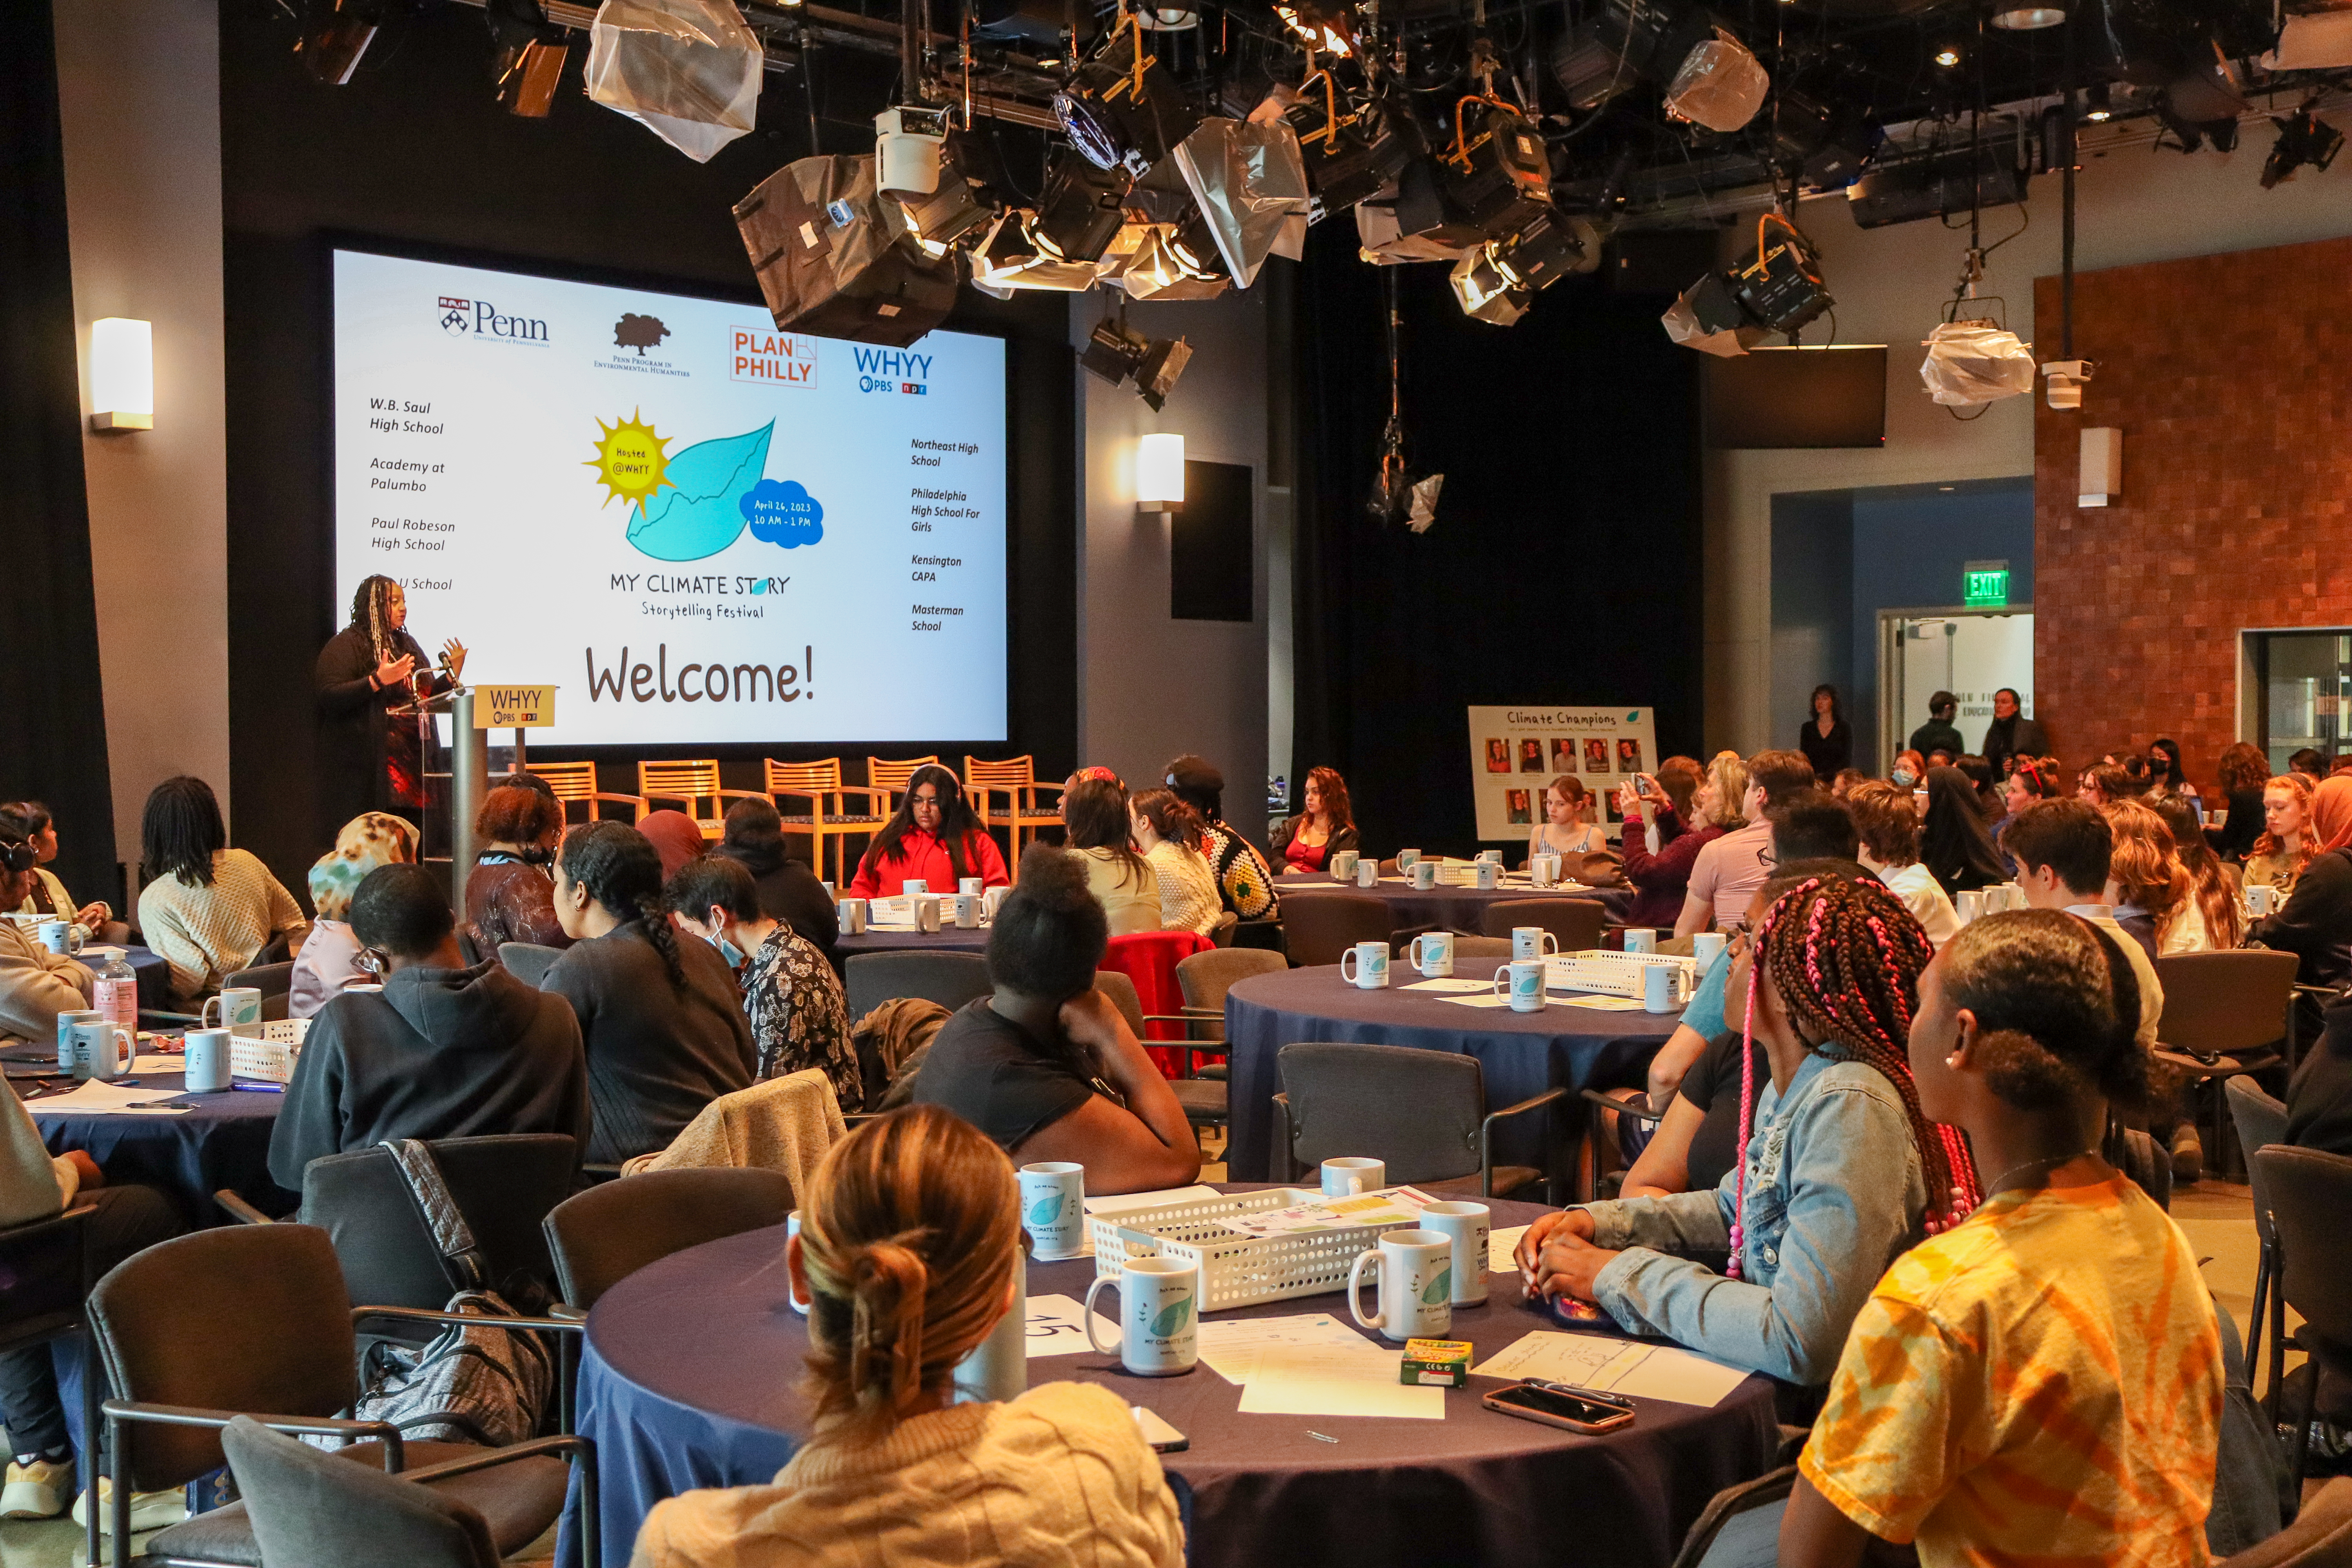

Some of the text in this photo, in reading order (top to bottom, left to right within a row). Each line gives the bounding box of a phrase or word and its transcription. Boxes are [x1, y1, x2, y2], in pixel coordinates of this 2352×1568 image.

[473, 301, 550, 341] Penn
[735, 332, 792, 357] PLAN
[735, 356, 811, 382] PHILLY
[853, 347, 933, 379] WHYY
[874, 380, 926, 395] PBS npr
[370, 397, 431, 414] W.B. Saul
[370, 417, 444, 434] High School
[617, 448, 645, 458] Hosted
[911, 439, 979, 455] Northeast High
[370, 457, 445, 475] Academy at
[911, 455, 941, 466] School
[613, 463, 650, 475] @WHYY
[371, 478, 426, 492] Palumbo
[911, 488, 967, 502] Philadelphia
[754, 500, 811, 513] April 26, 2023
[911, 505, 980, 519] High School For
[371, 517, 455, 532] Paul Robeson
[754, 515, 765, 524] 10
[768, 516, 782, 525] AM
[790, 518, 795, 526] 1
[799, 518, 811, 526] PM
[911, 521, 932, 532] Girls
[372, 537, 445, 551] High School
[911, 554, 962, 568] Kensington
[400, 577, 452, 590] U School
[612, 573, 640, 592] MY
[647, 575, 728, 594] CLIMATE
[912, 571, 936, 582] CAPA
[1970, 573, 2001, 596] EXIT
[642, 601, 764, 620] Storytelling Festival
[912, 604, 964, 615] Masterman
[912, 621, 942, 631] School
[586, 643, 813, 702] Welcome!
[490, 690, 542, 709] WHYY
[503, 713, 515, 722] PBS
[1508, 711, 1617, 727] Climate Champions
